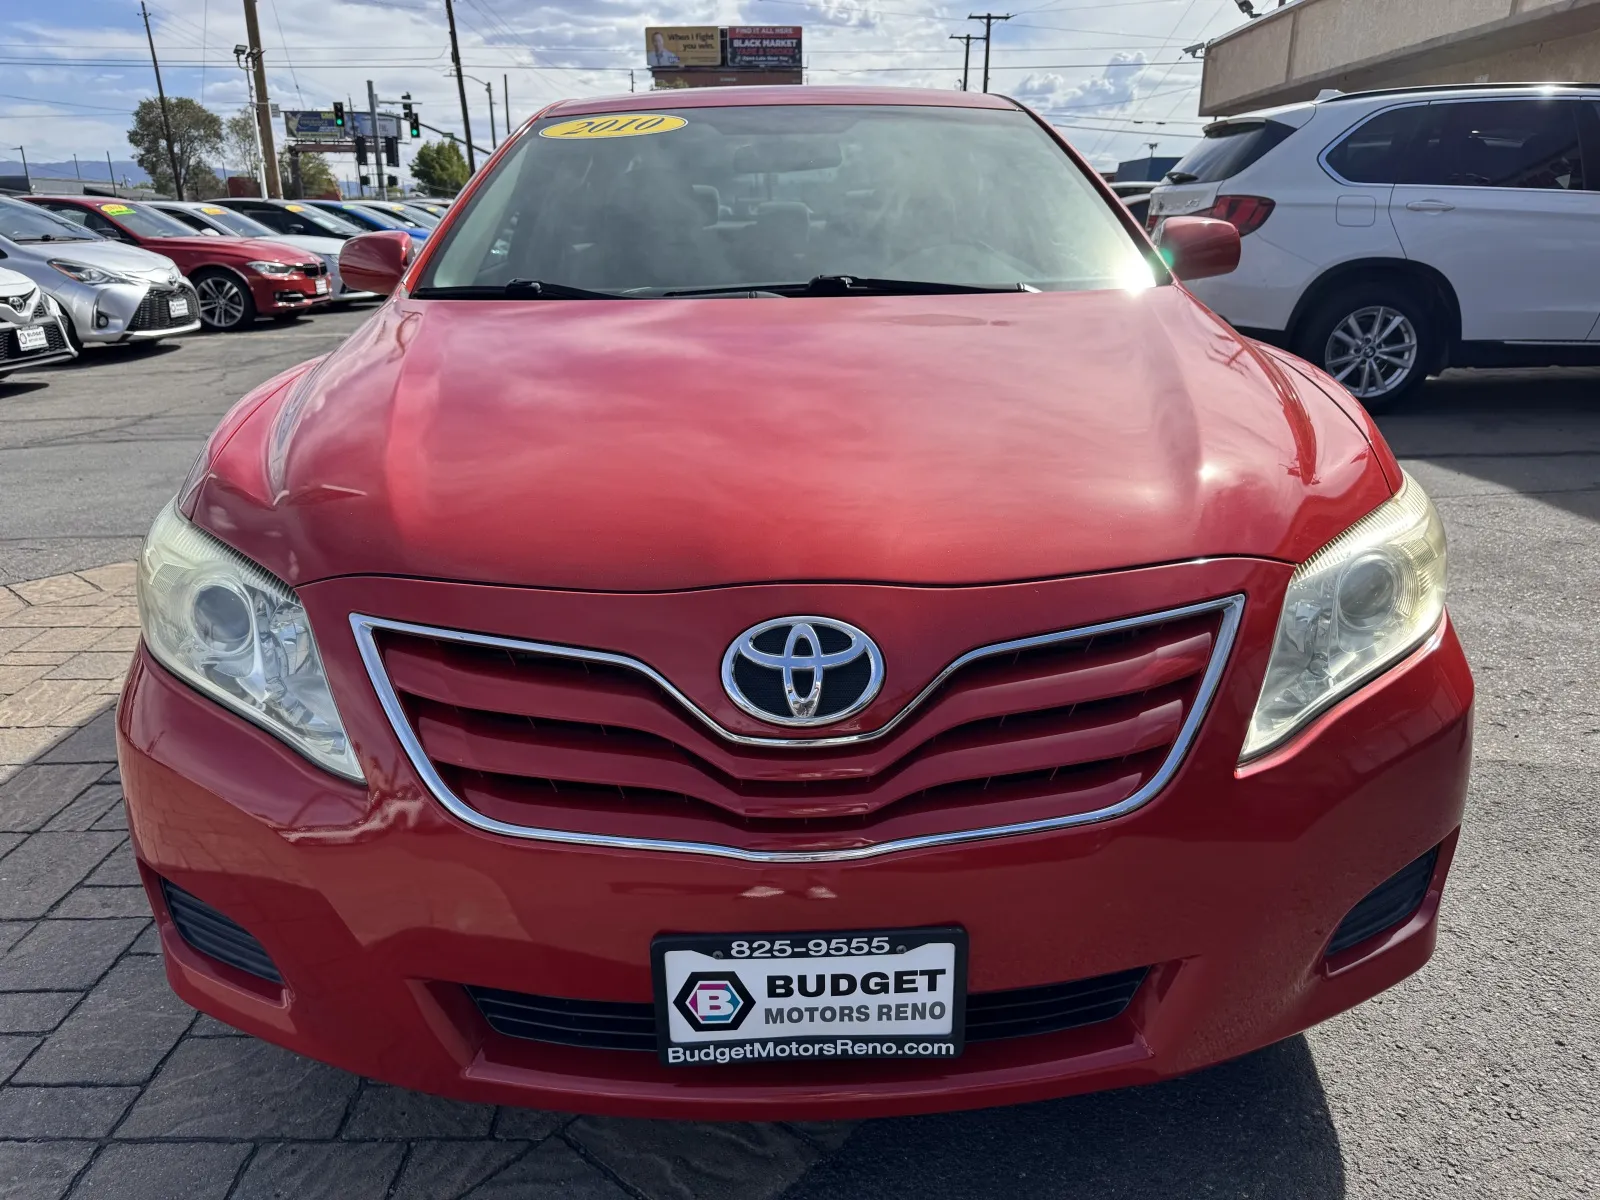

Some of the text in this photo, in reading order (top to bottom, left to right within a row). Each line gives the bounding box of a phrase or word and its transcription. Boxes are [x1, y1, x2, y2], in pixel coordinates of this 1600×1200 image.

[667, 32, 690, 41] When
[695, 31, 715, 43] fight
[682, 42, 715, 52] you win.
[733, 39, 798, 48] BLACK MARKET
[560, 117, 666, 136] 2010
[730, 936, 891, 958] 825-9555
[766, 968, 947, 999] BUDGET
[696, 989, 734, 1017] B
[764, 1001, 946, 1025] MOTORS RENO
[667, 1038, 955, 1064] BudgetMotorsReno.com
